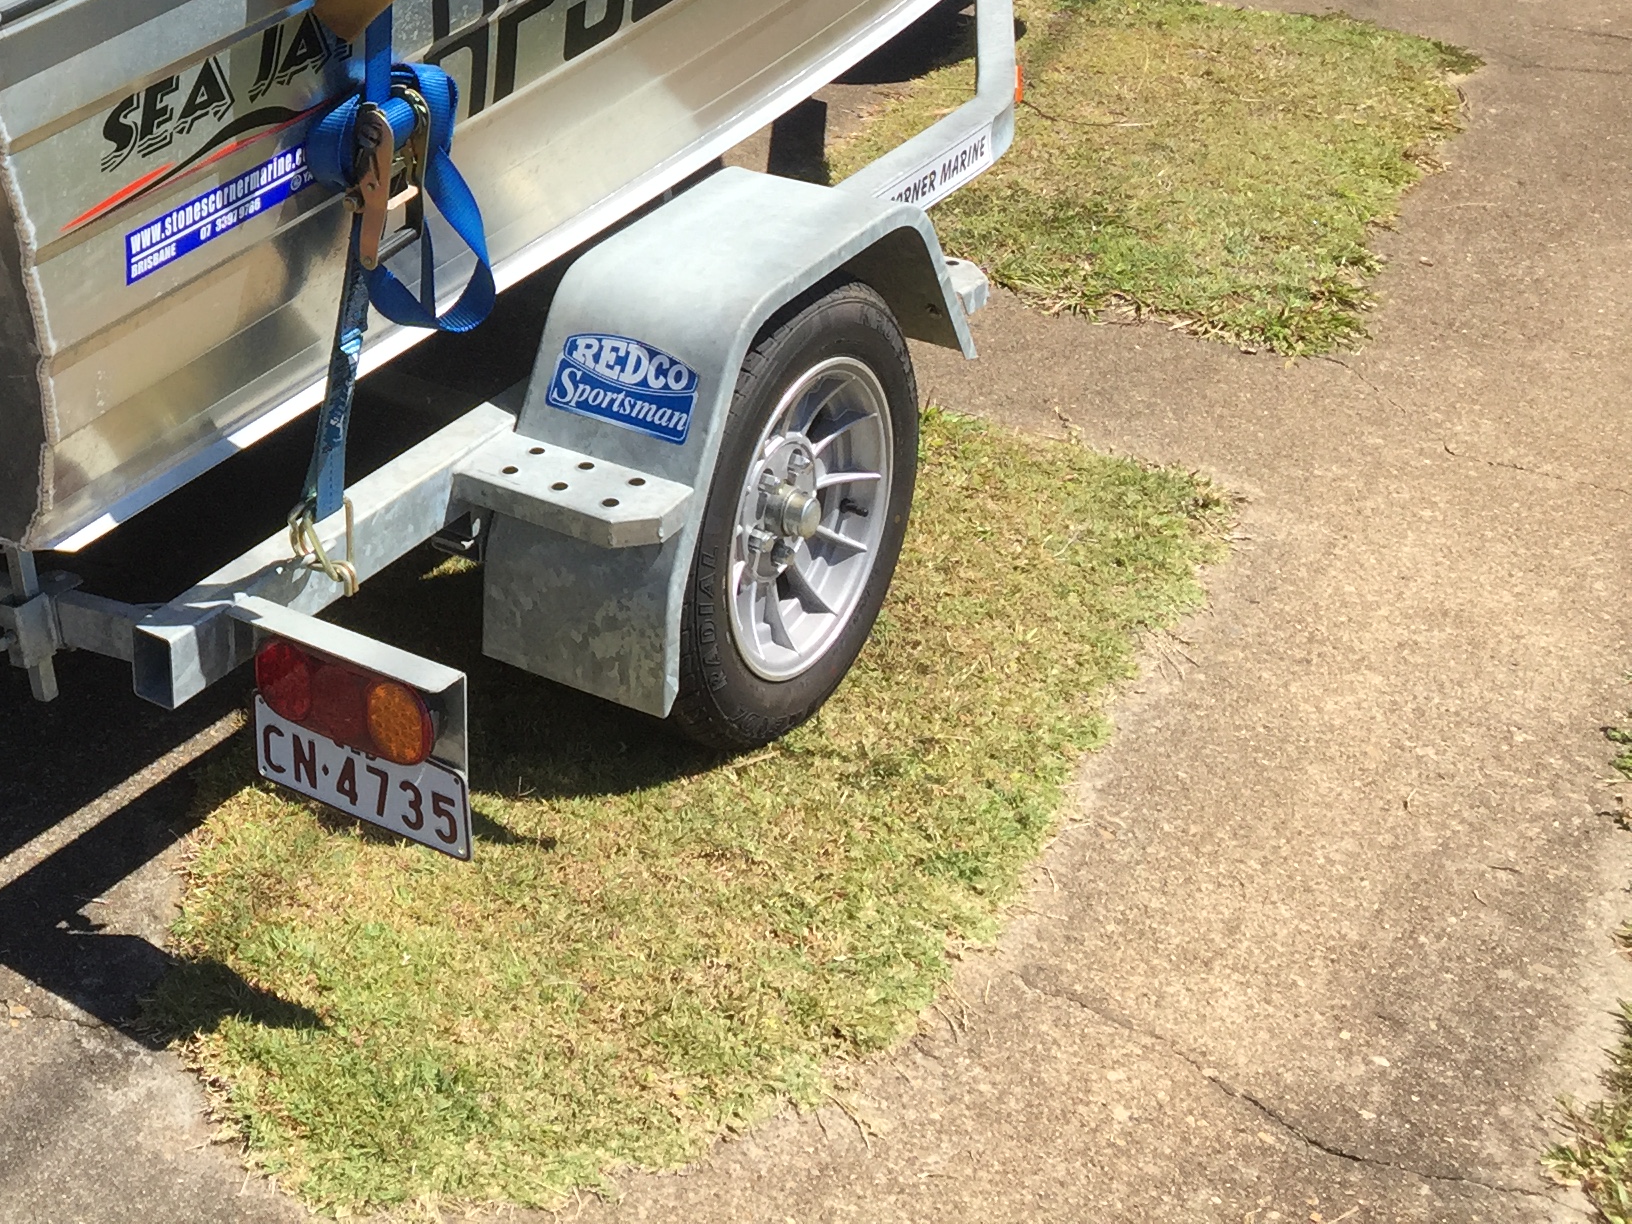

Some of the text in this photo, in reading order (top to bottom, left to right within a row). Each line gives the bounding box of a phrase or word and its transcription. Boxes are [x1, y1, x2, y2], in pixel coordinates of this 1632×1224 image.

[101, 10, 353, 173] SEA JA
[939, 135, 987, 186] MARINE
[130, 147, 306, 254] www.stonescornermarine.c
[131, 242, 176, 278] BRISBANE
[199, 226, 212, 241] 07
[572, 338, 689, 390] REDCO
[551, 367, 689, 432] Sportsman
[698, 545, 728, 693] RADIAL
